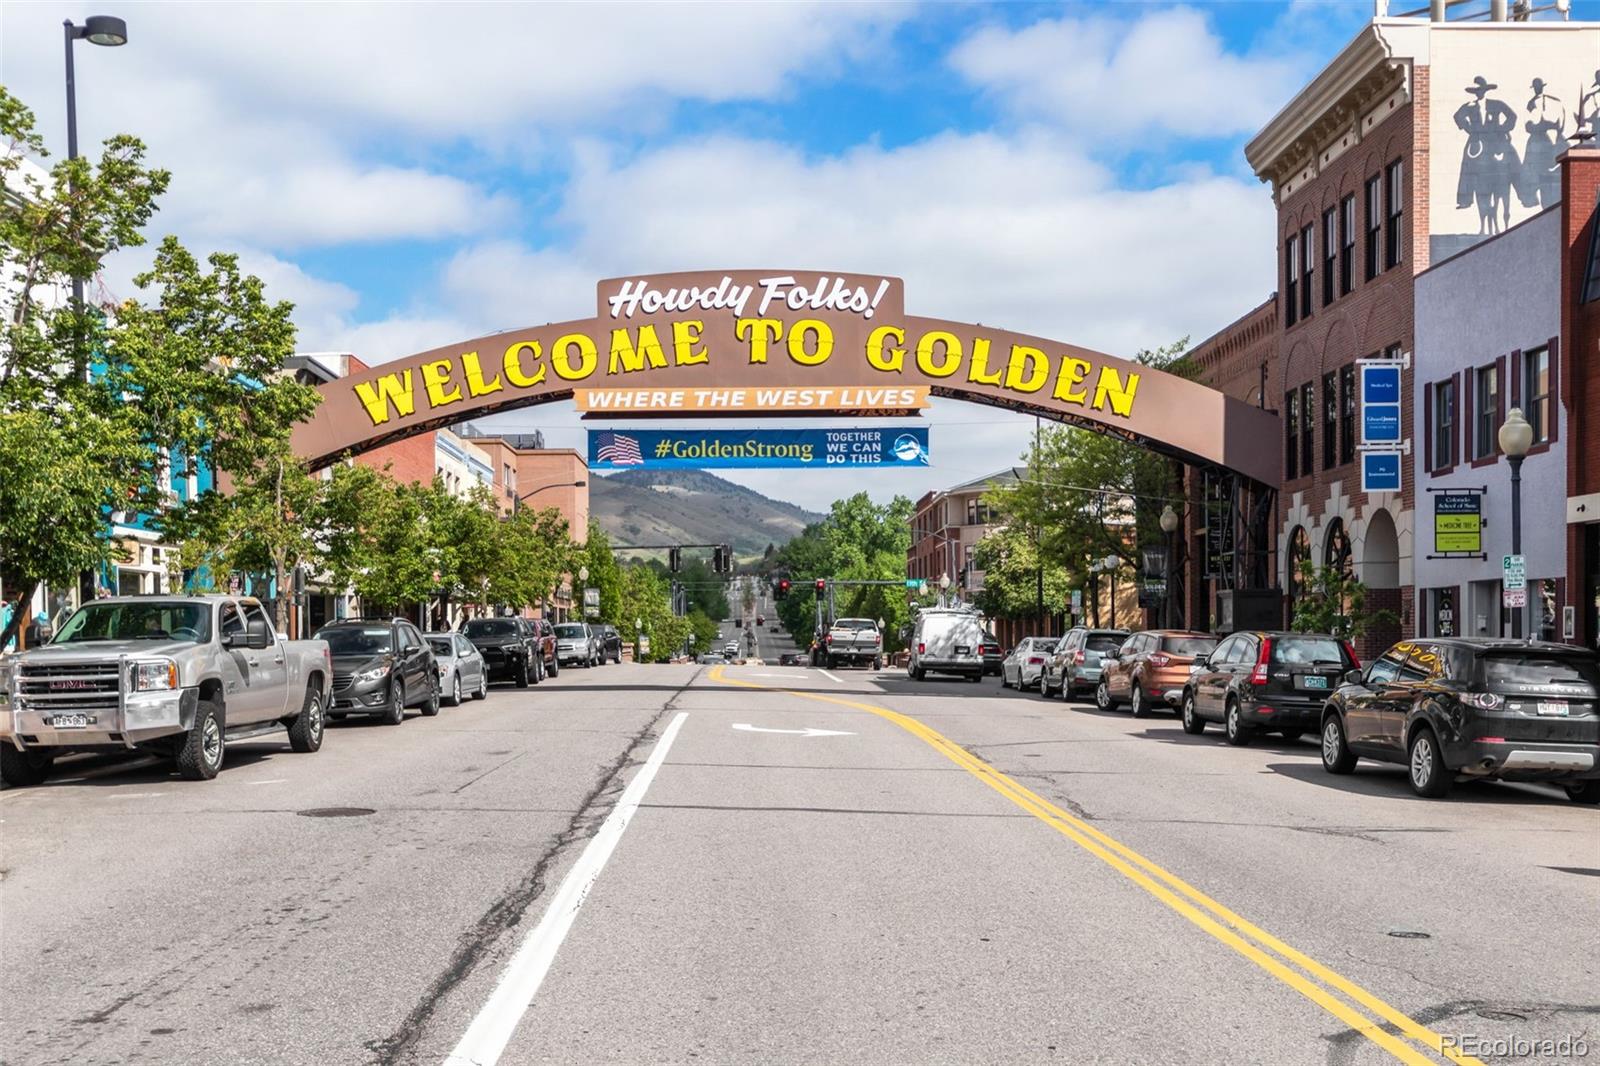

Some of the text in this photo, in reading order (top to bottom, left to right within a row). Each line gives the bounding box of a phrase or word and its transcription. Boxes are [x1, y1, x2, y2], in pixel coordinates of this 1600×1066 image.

[608, 276, 890, 319] Howdy Folks!
[354, 318, 1141, 425] WELCOME TO GOLDEN
[587, 388, 916, 409] WHERE THE WEST LIVES
[826, 432, 881, 442] TOGETHER
[654, 439, 814, 463] #GoldenStrong
[826, 443, 881, 452] WE CAN
[826, 453, 881, 464] DO THIS
[49, 680, 97, 690] GMC
